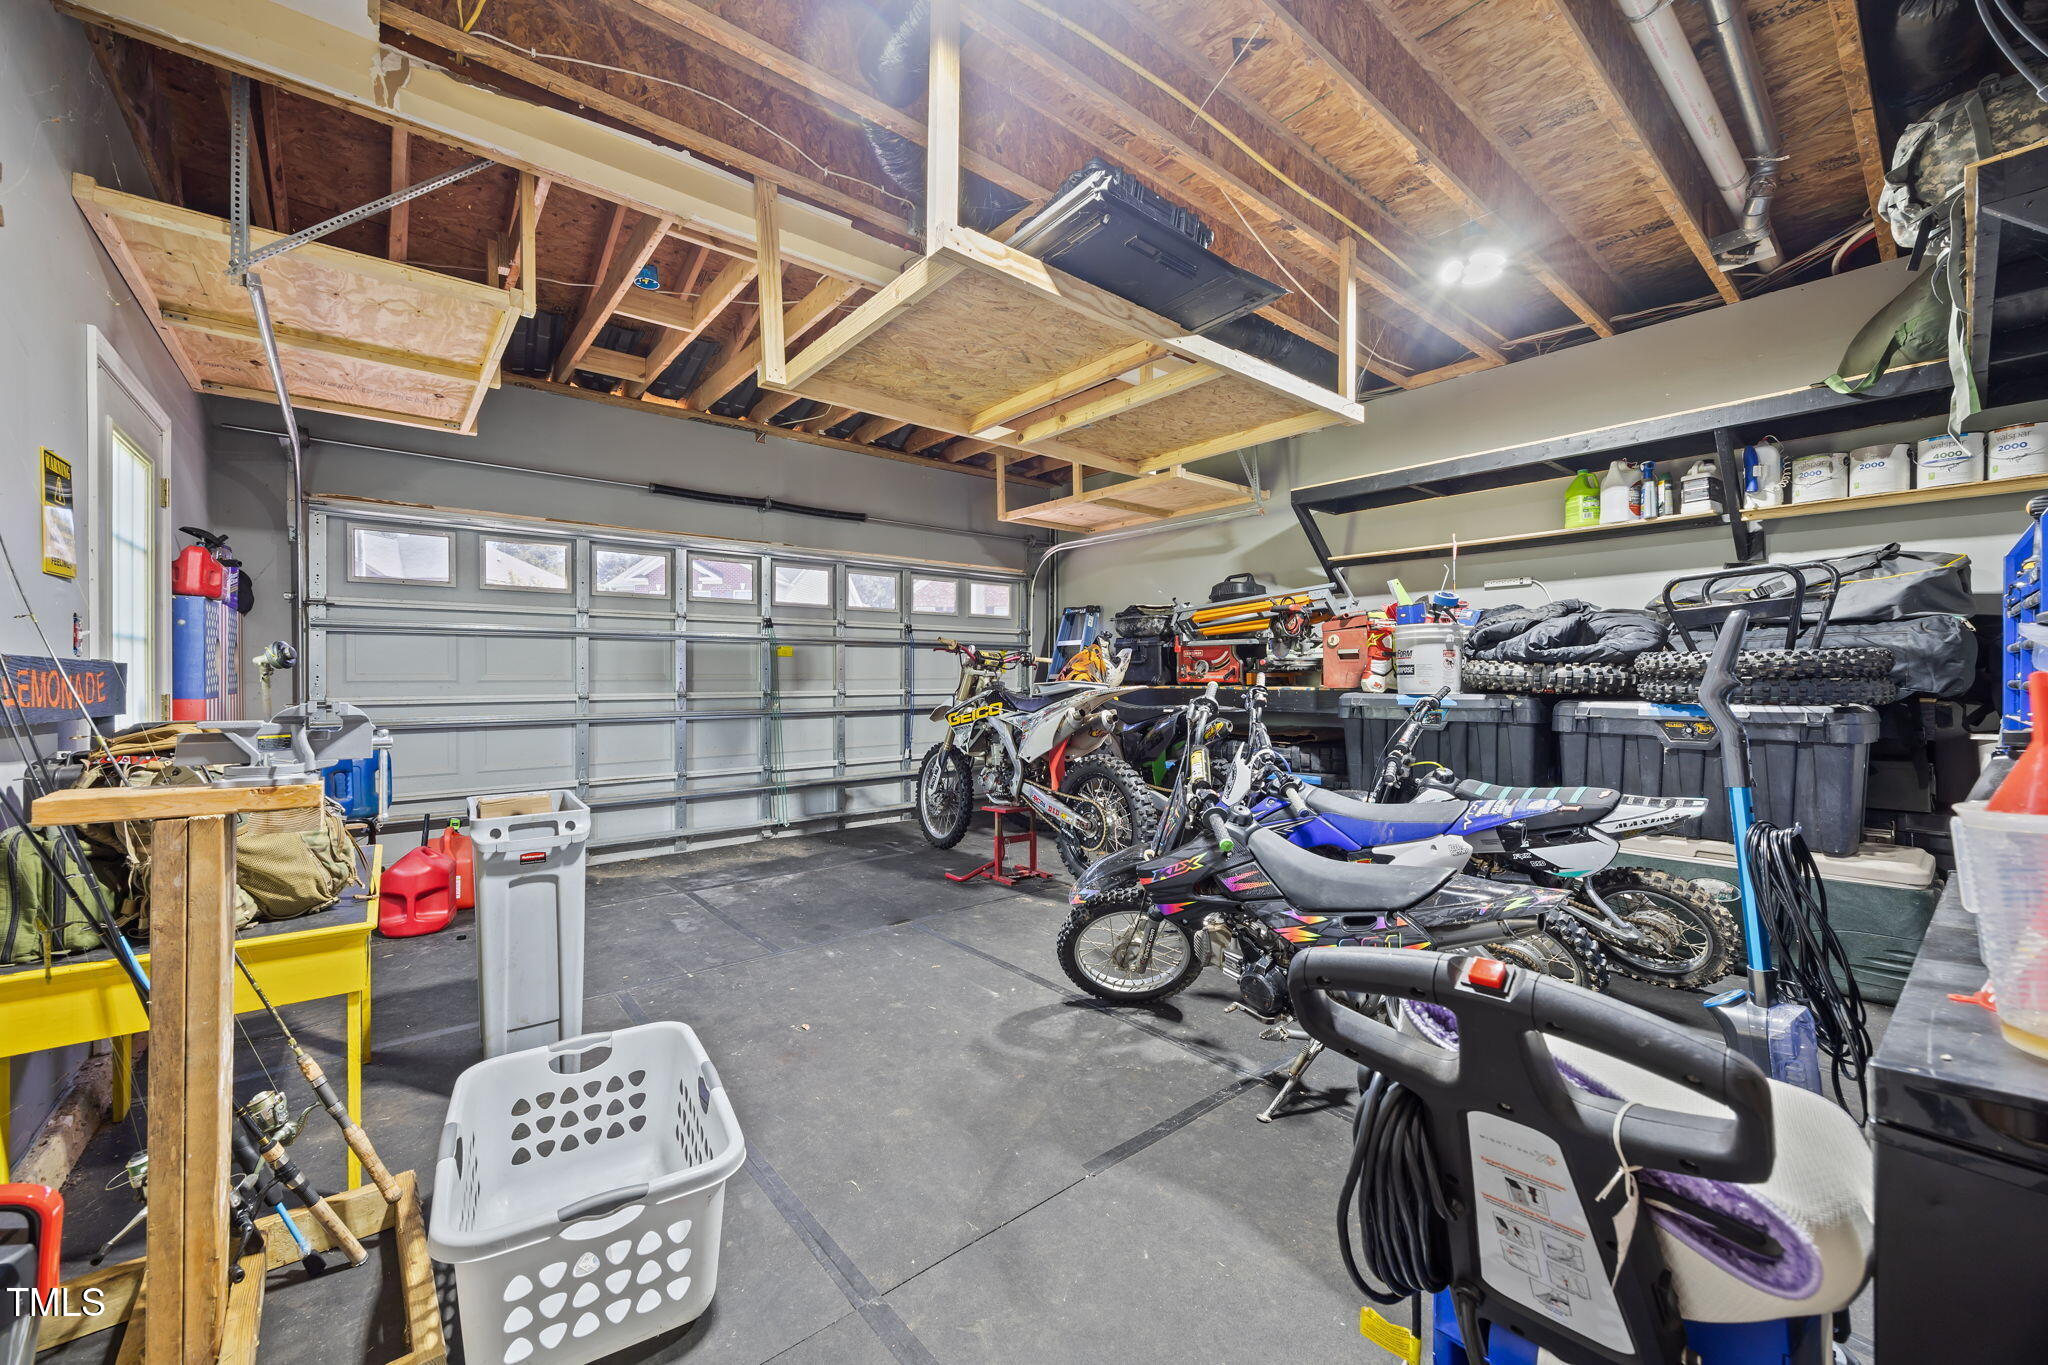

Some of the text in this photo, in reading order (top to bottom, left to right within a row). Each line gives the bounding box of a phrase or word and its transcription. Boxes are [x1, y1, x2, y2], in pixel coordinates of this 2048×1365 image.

[1997, 431, 2031, 442] valspar
[1998, 442, 2027, 451] 2000
[1933, 450, 1963, 460] 4000
[1859, 461, 1885, 470] 2000
[1799, 470, 1822, 478] 2000
[2, 669, 107, 710] LEMONADE
[948, 702, 1003, 726] GEICO
